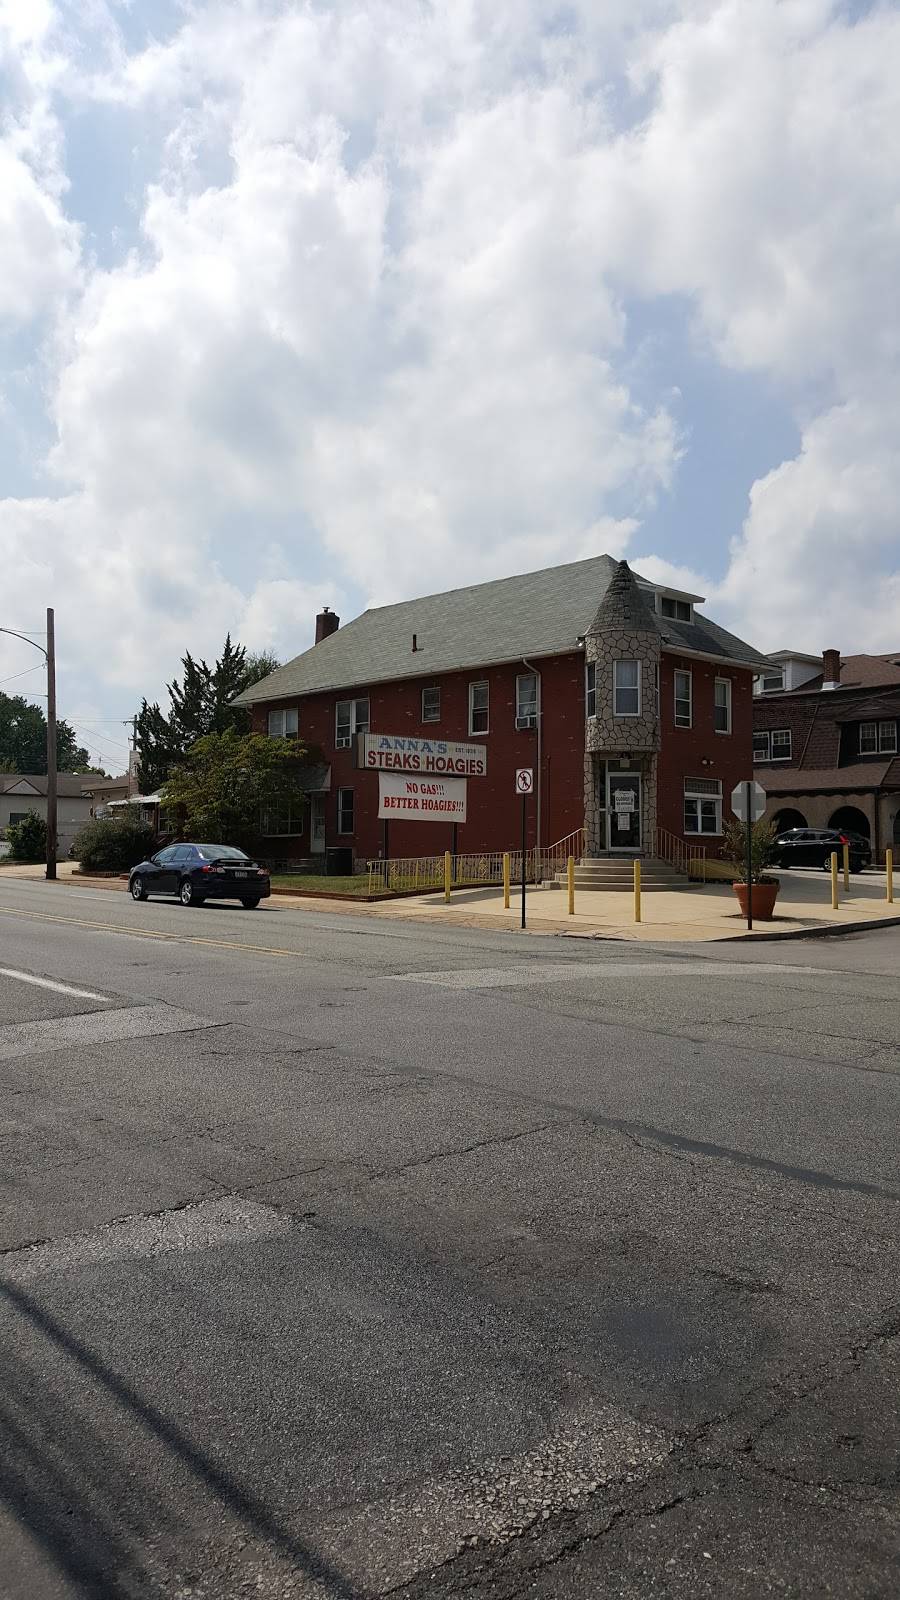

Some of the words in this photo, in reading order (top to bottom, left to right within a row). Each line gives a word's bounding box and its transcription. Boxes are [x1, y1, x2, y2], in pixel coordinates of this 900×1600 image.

[379, 737, 448, 754] ANNA'S
[368, 751, 420, 769] STEAKS
[426, 756, 484, 774] HOAGIES
[406, 782, 418, 793] NO
[420, 783, 445, 795] GAS!!!
[384, 797, 419, 809] BETTER
[421, 798, 464, 812] HOAGIES!!!
